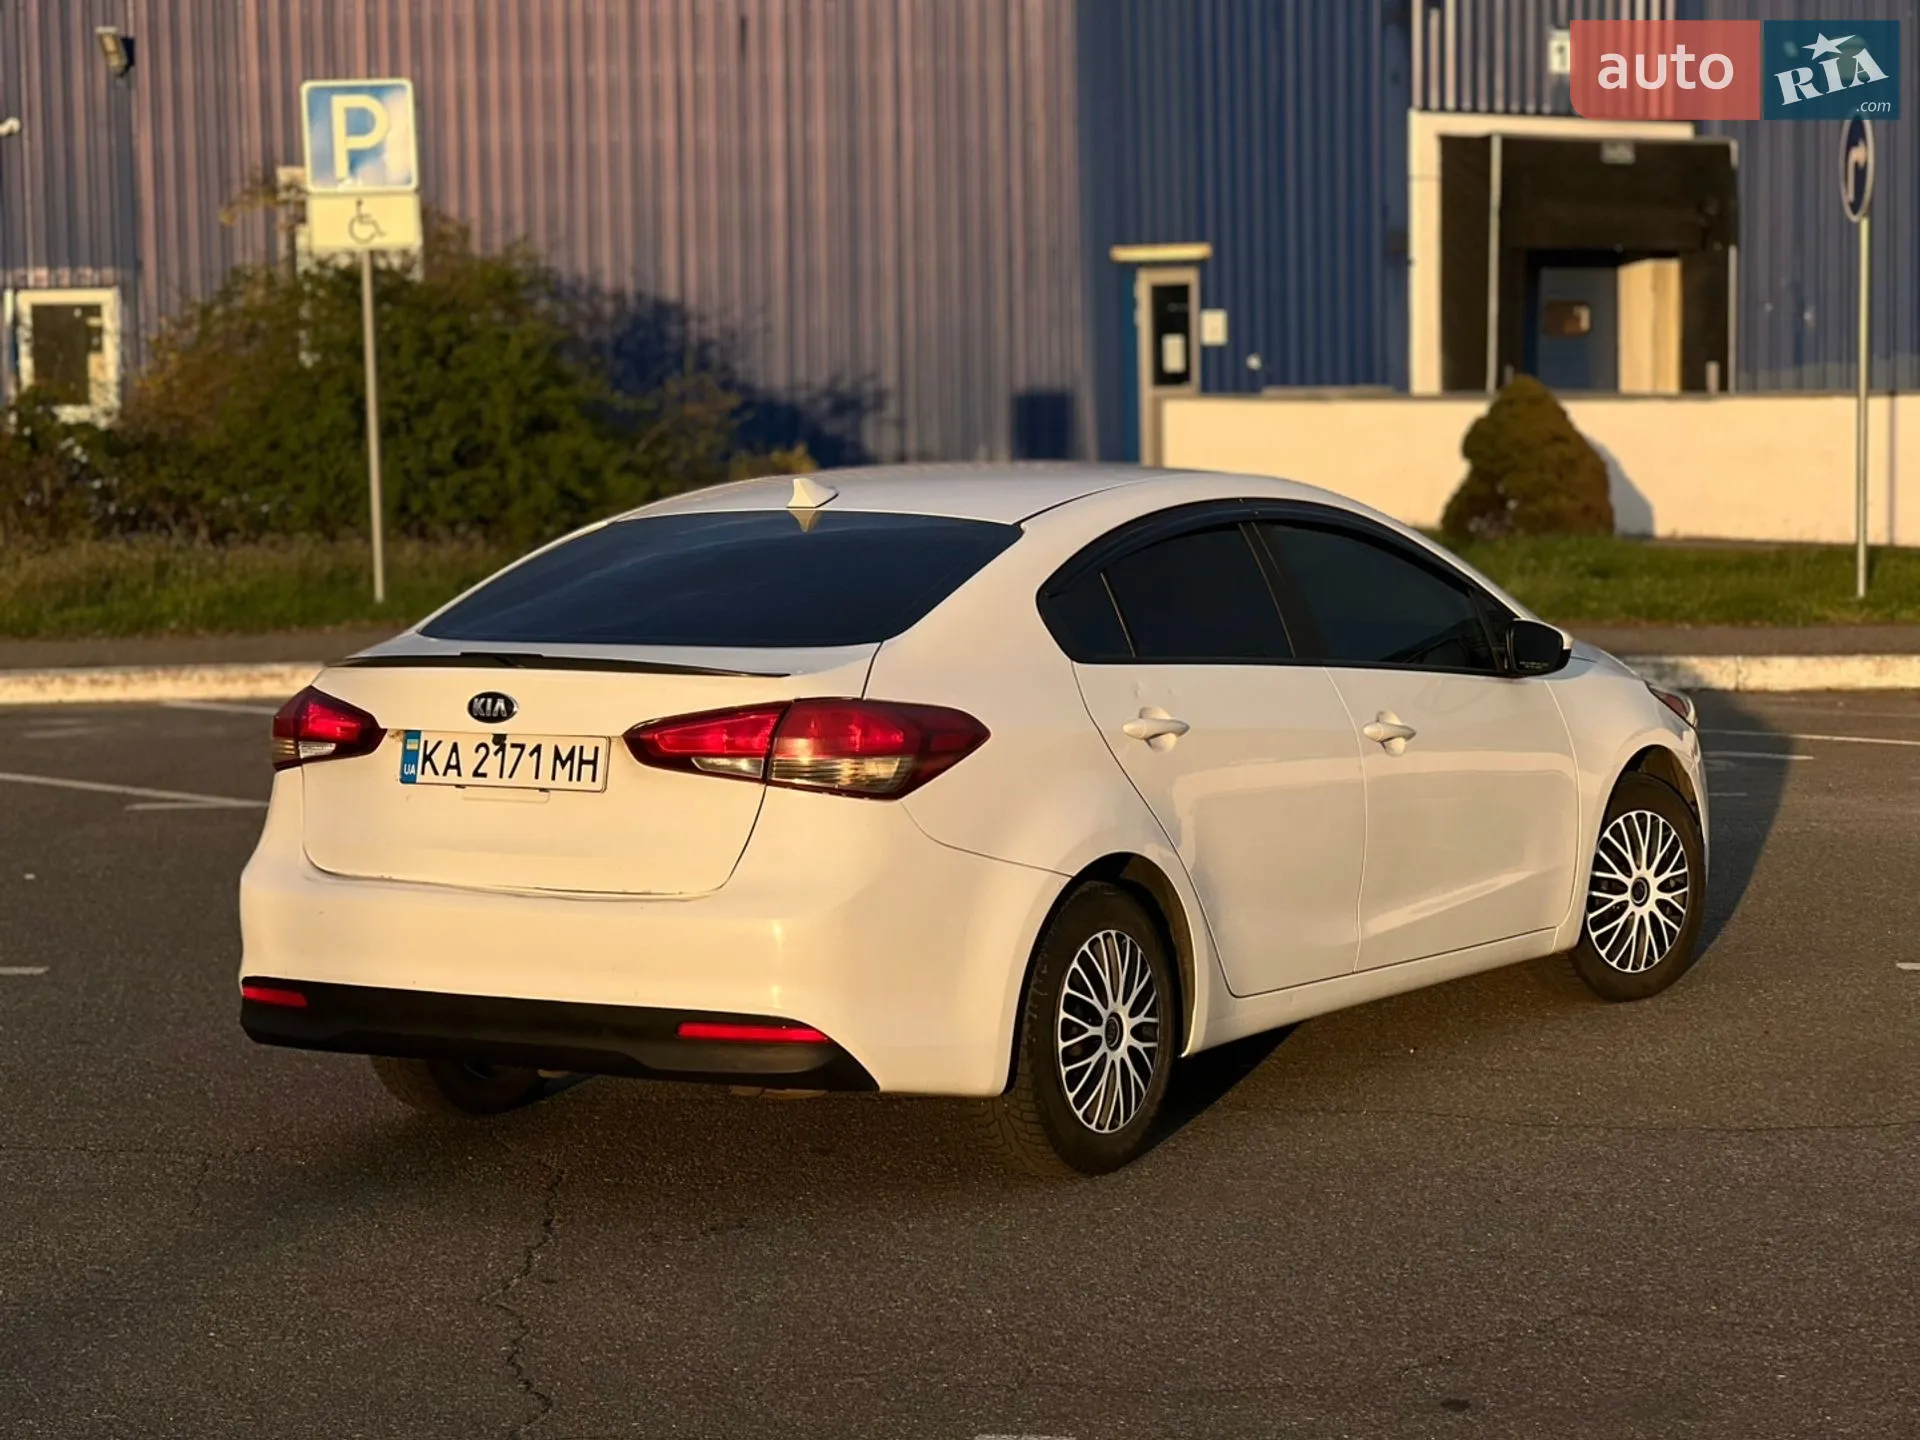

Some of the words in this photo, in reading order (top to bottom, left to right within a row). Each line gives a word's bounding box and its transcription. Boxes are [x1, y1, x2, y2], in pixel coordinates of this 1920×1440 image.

[331, 94, 388, 179] P
[472, 698, 508, 717] KIA
[403, 764, 416, 776] UA
[421, 740, 462, 777] KA
[472, 742, 542, 780] 2171
[551, 744, 599, 783] MH
